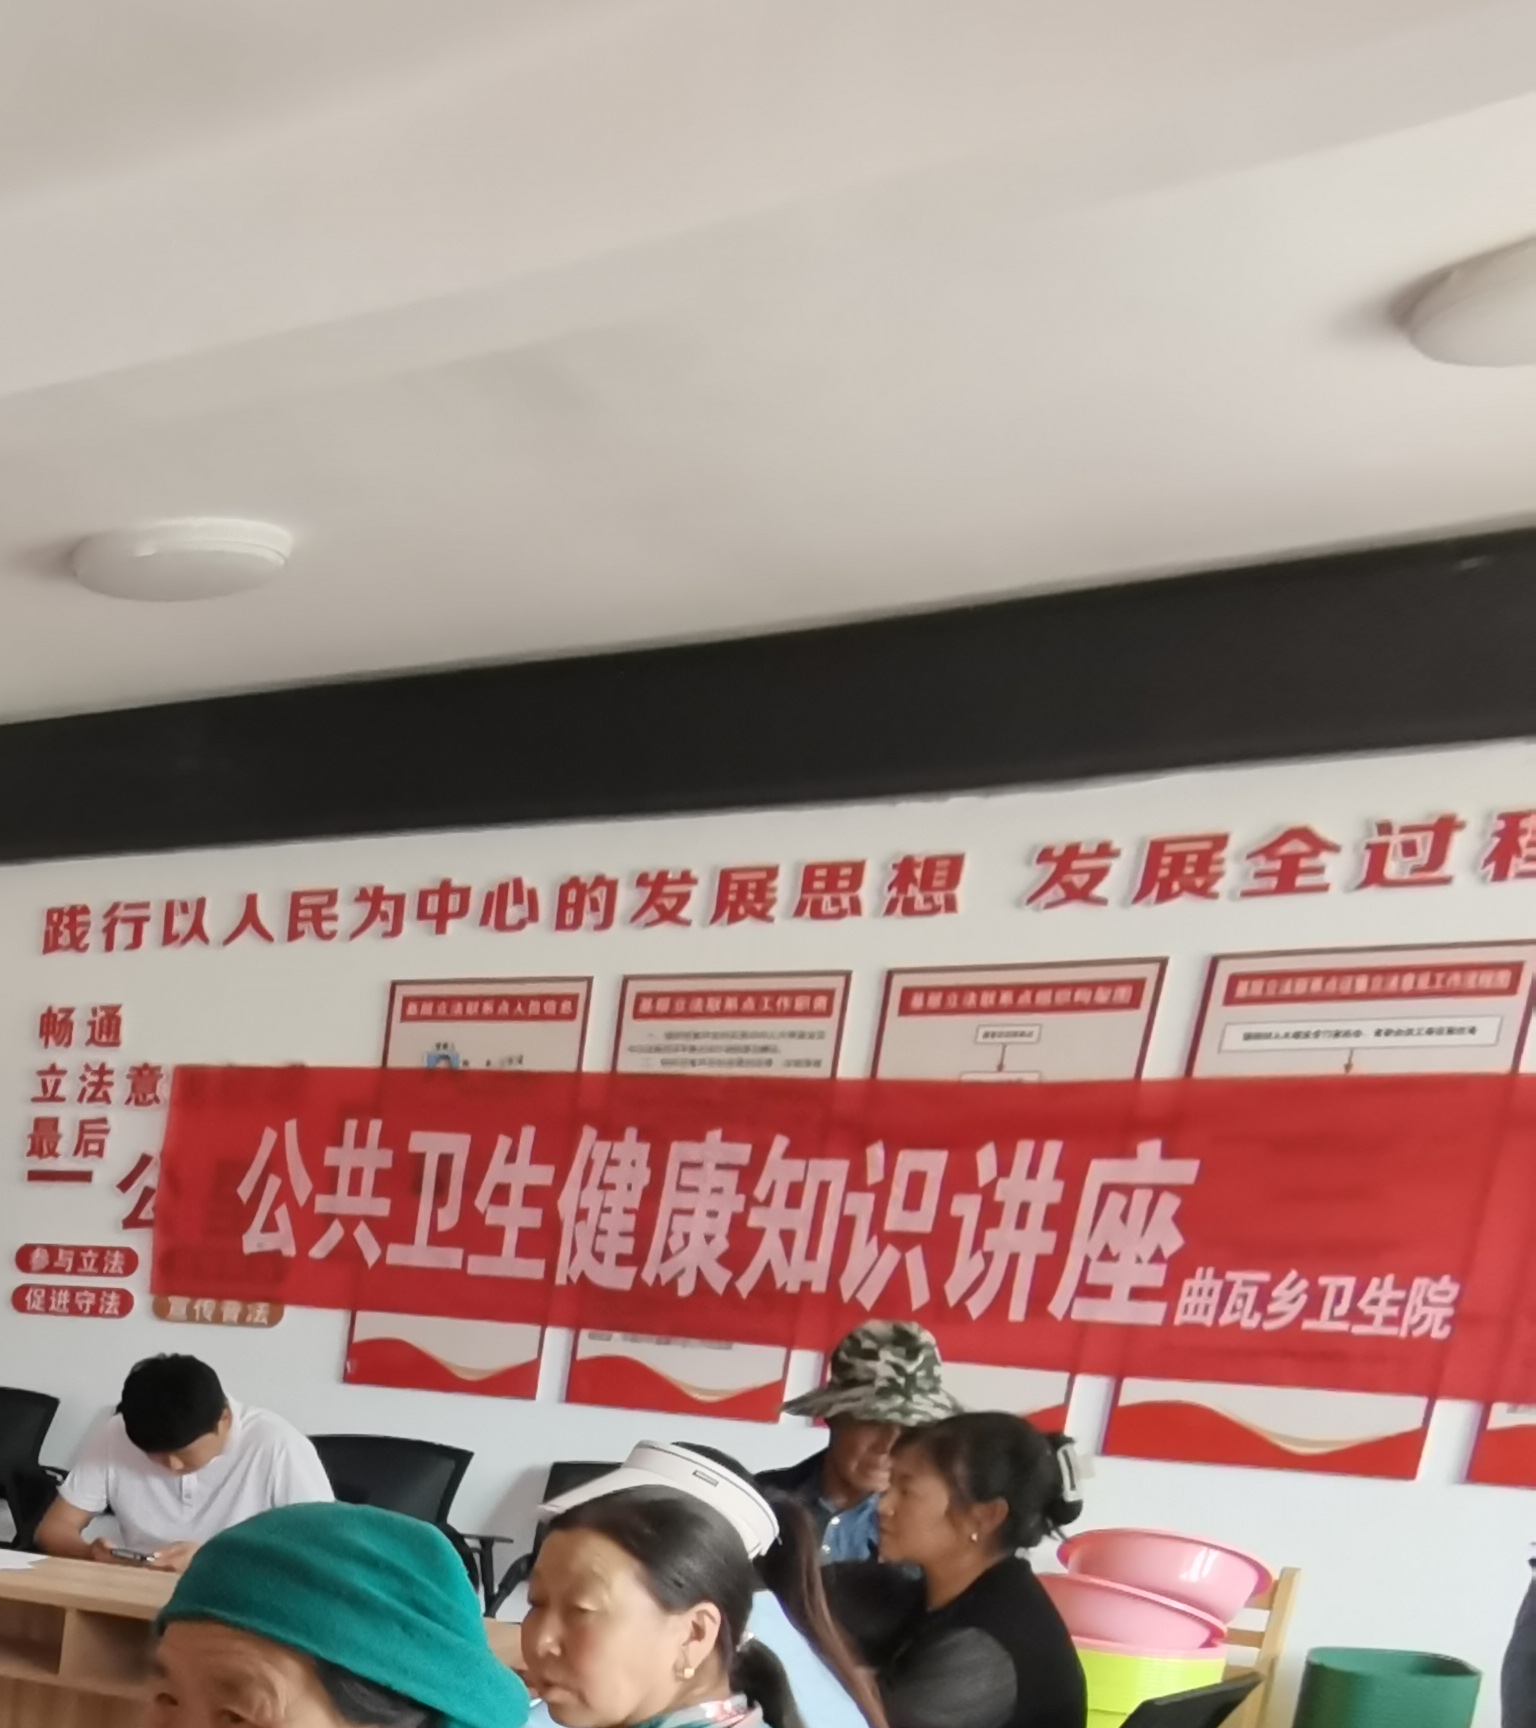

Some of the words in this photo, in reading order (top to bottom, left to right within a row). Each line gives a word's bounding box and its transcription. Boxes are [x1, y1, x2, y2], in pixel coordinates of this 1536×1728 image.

[41, 855, 965, 955] 践行以人民为中心的发展思想
[39, 1004, 122, 1049] 畅通
[26, 1117, 110, 1159] 最后
[237, 1119, 1201, 1326] 公共卫生健康知识讲座
[29, 1246, 125, 1275] 参与立法
[25, 1286, 121, 1316] 促进守法
[1175, 1267, 1460, 1340] 曲瓦乡卫生院
